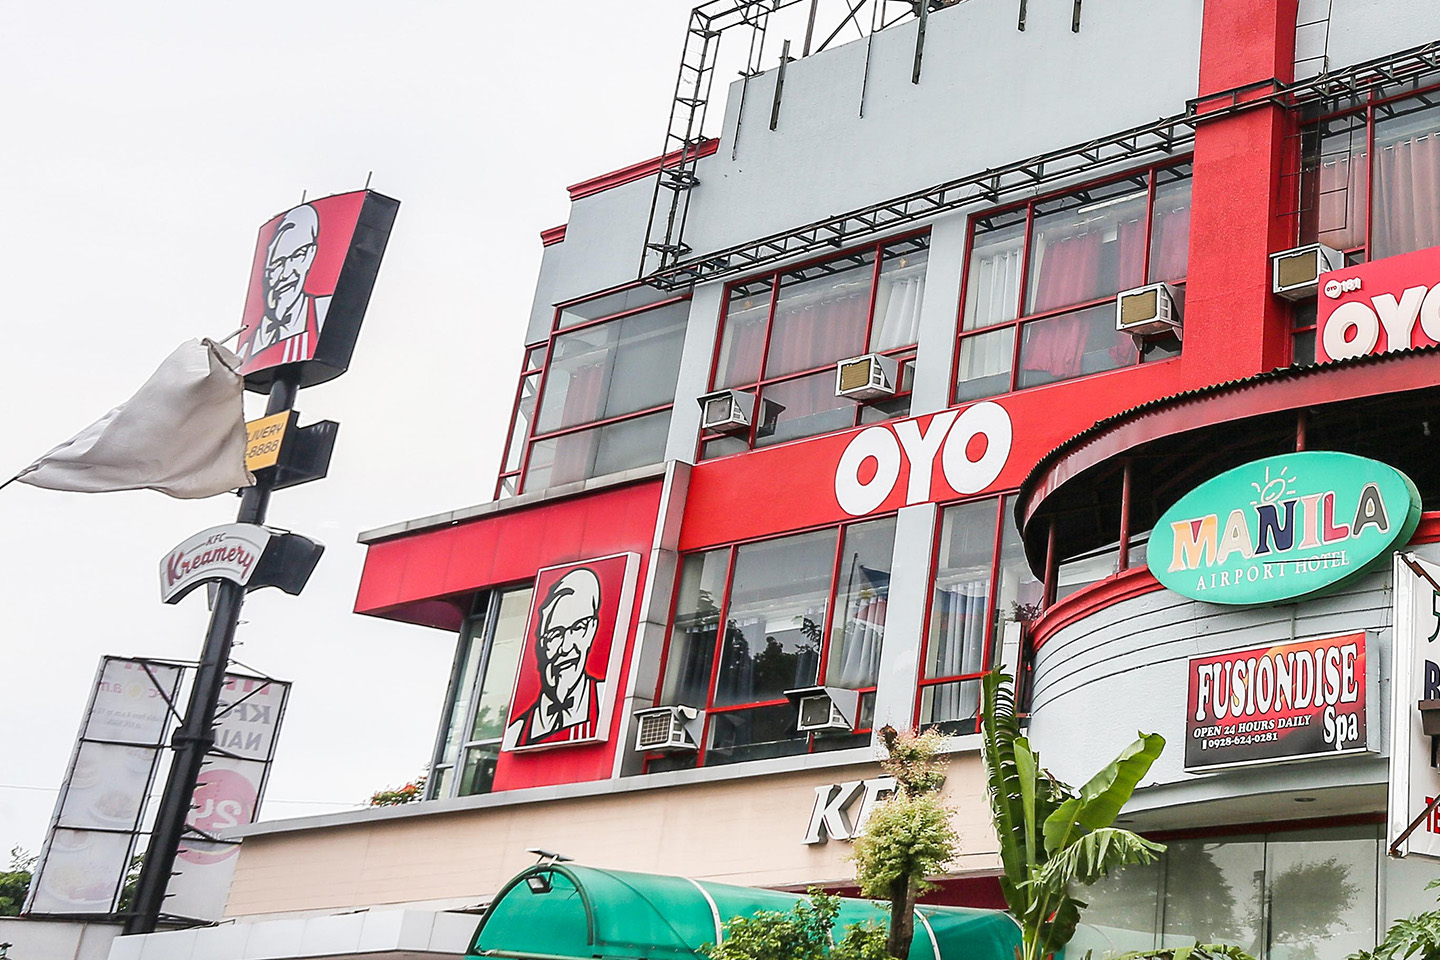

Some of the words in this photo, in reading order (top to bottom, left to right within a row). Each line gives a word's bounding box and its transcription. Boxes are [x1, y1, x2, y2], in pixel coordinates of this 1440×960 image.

[835, 401, 1013, 516] OYO
[205, 532, 227, 546] KFC
[1168, 482, 1391, 573] MANILA
[167, 546, 254, 586] Kreamery
[1196, 560, 1287, 591] AIRPORT
[1295, 550, 1350, 574] HOTEL
[1195, 642, 1359, 722] FUSIONDISE
[1193, 725, 1223, 739] OPEN
[1223, 724, 1236, 735] 24
[1237, 720, 1275, 735] HOURS
[1277, 714, 1312, 729] DAILY
[1208, 732, 1279, 749] 0928-624-0281
[1323, 705, 1359, 751] Spa
[800, 774, 946, 845] KF
